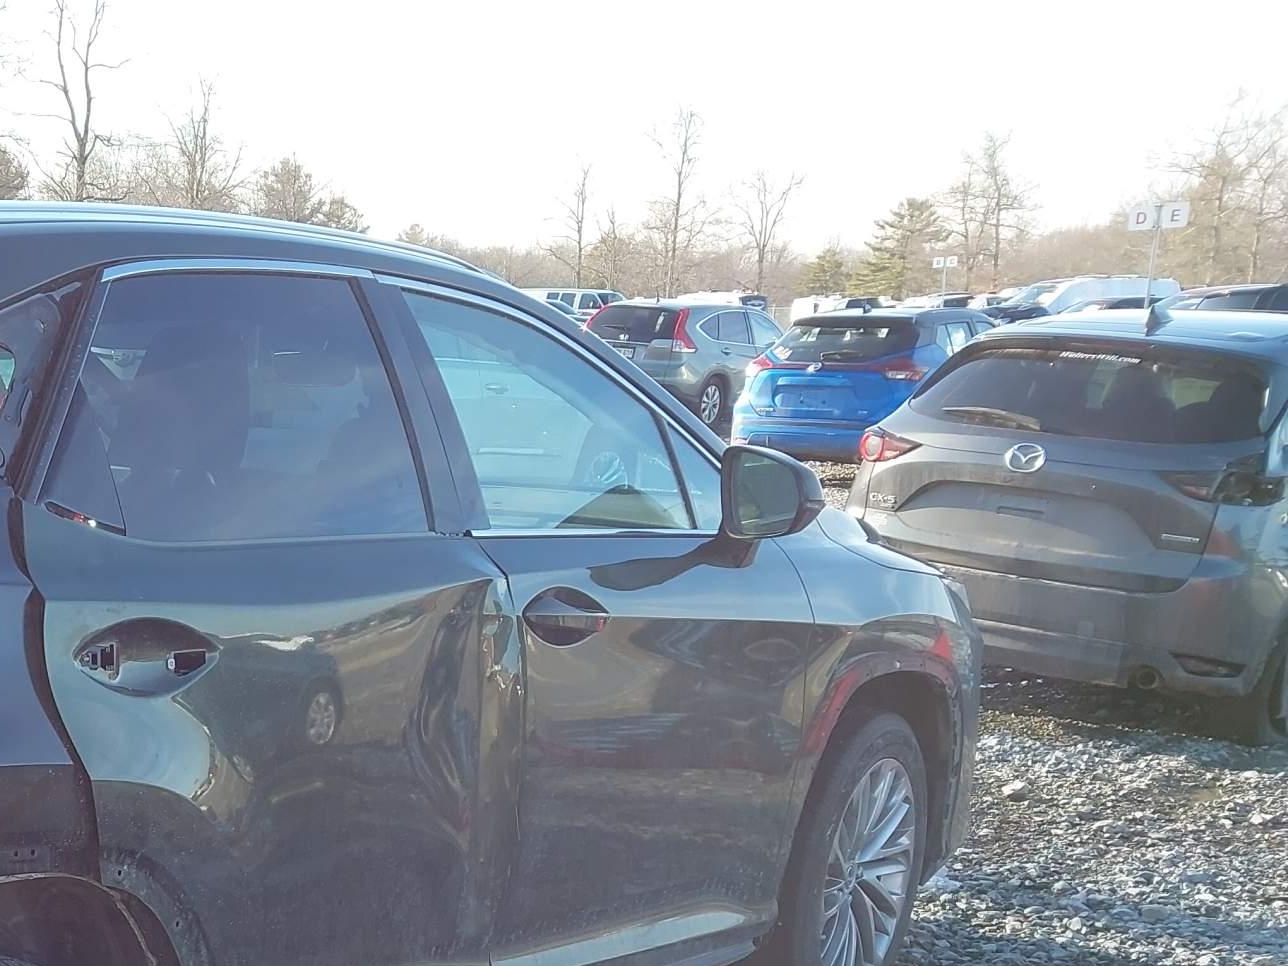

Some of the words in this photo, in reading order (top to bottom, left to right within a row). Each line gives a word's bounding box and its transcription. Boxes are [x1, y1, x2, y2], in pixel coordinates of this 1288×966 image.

[1135, 211, 1147, 224] D
[1170, 208, 1182, 222] E
[869, 491, 897, 504] CX-5
